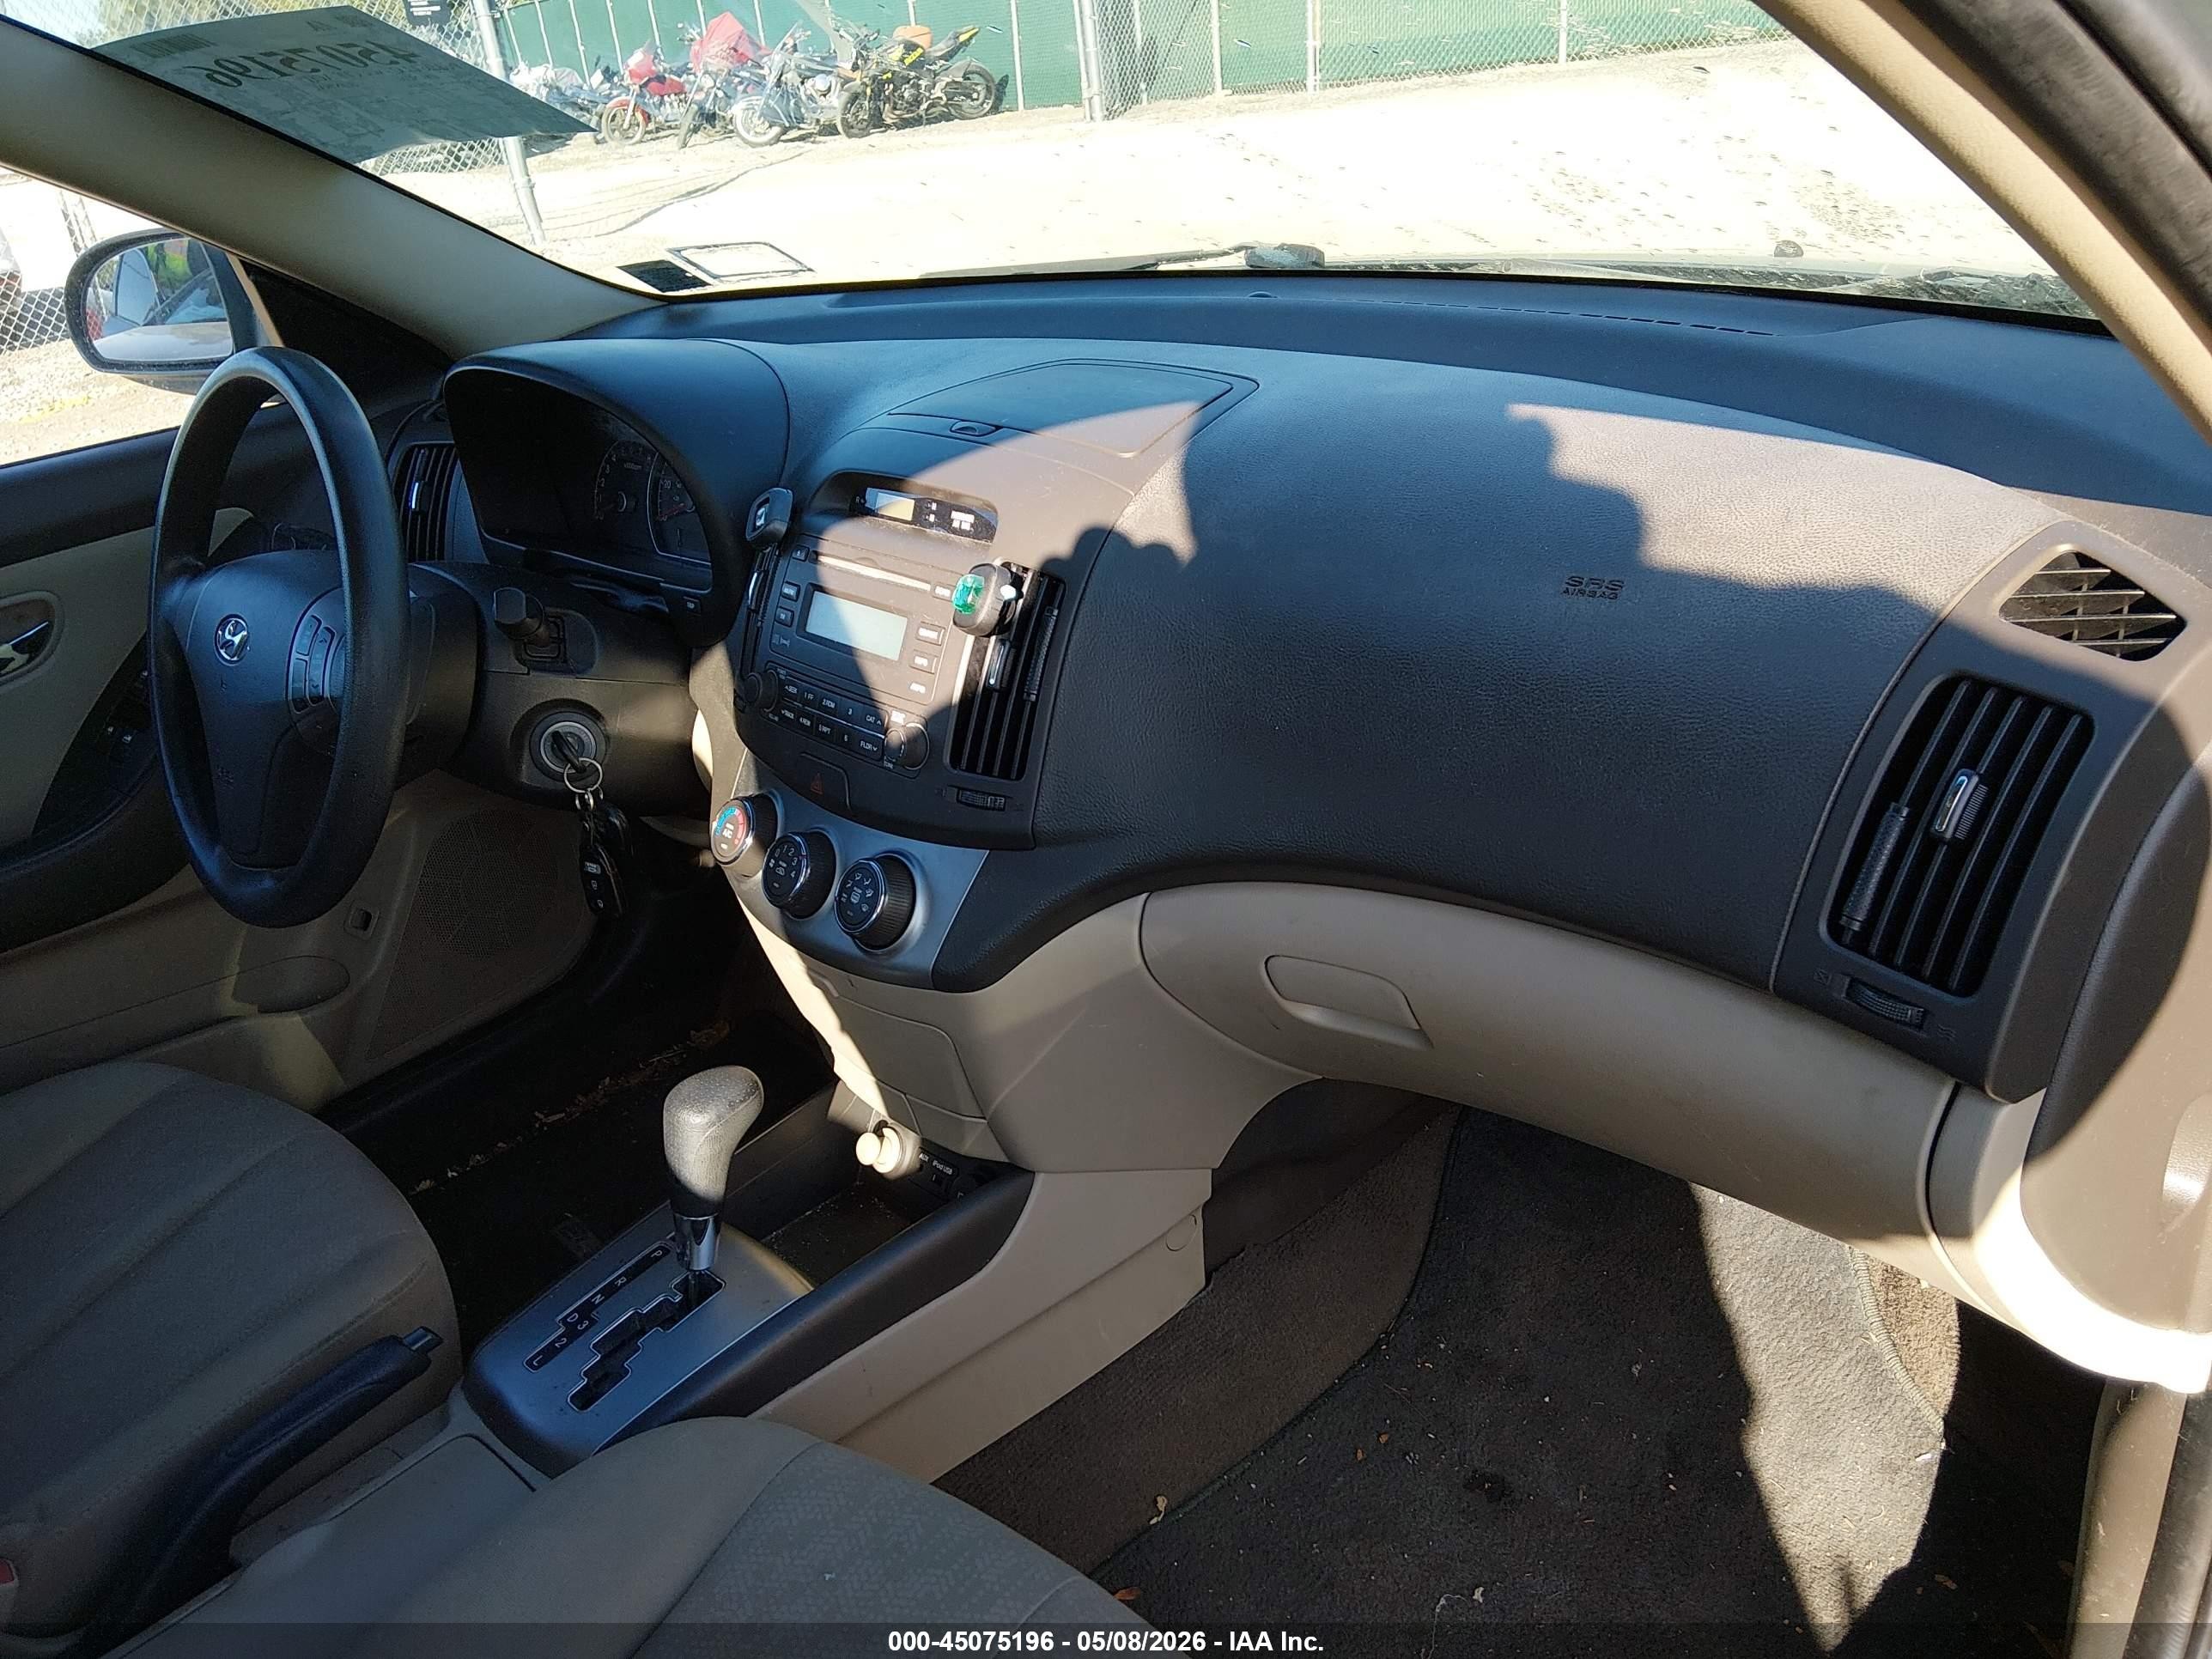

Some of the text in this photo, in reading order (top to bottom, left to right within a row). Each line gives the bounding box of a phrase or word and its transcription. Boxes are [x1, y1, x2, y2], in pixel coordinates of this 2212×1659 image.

[1565, 576, 1625, 591] SRS
[1562, 586, 1619, 600] AIRBAG
[866, 714, 876, 723] CAT
[860, 740, 873, 750] FLDR
[775, 848, 781, 858] 0
[788, 848, 795, 856] 2
[791, 857, 798, 866] 3
[614, 1276, 627, 1286] R
[592, 1294, 605, 1304] N
[567, 1313, 579, 1322] D
[577, 1320, 589, 1330] 3
[555, 1338, 568, 1348] 2
[532, 1355, 543, 1366] L
